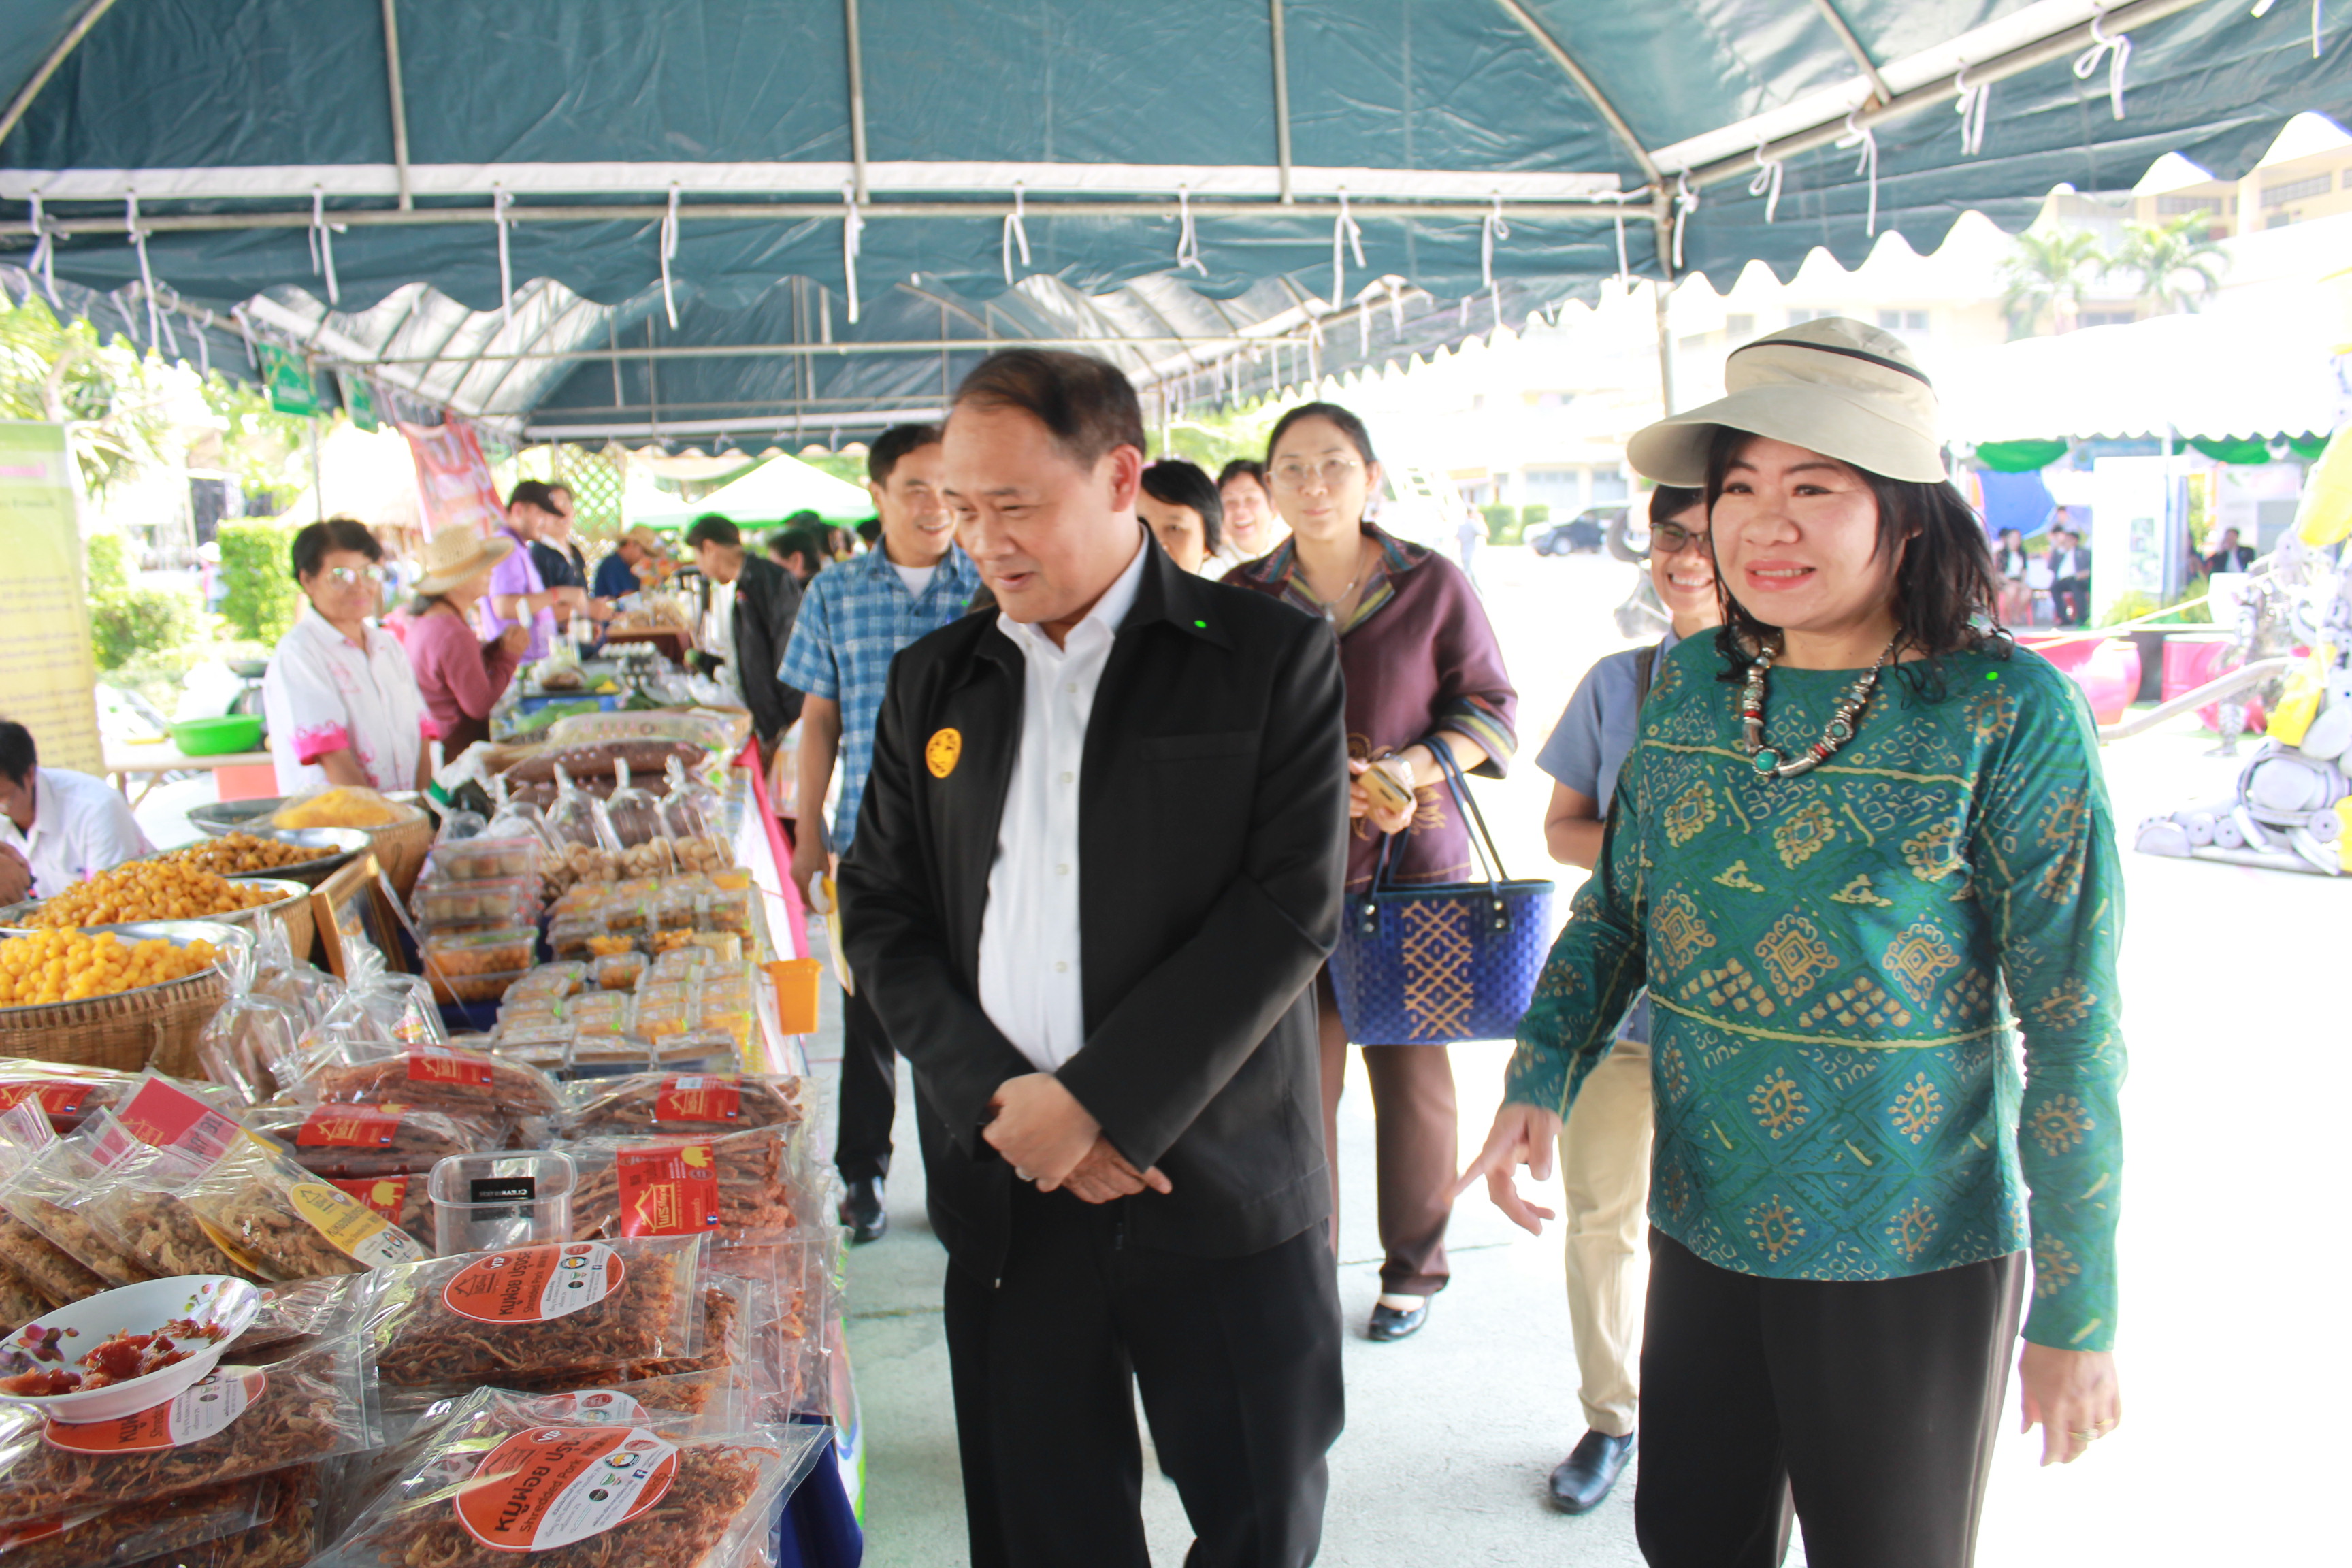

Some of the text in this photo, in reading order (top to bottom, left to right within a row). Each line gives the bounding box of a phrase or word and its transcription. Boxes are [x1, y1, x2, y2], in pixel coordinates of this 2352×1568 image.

[490, 1256, 505, 1269] VIP
[499, 1280, 523, 1315] หมูฝอย
[523, 1284, 540, 1313] Shredded
[532, 1271, 544, 1284] Pork
[538, 1430, 561, 1442] VIP
[495, 1466, 551, 1531] หมูฝอย
[520, 1480, 562, 1532] Shredded
[557, 1459, 583, 1479] Pork
